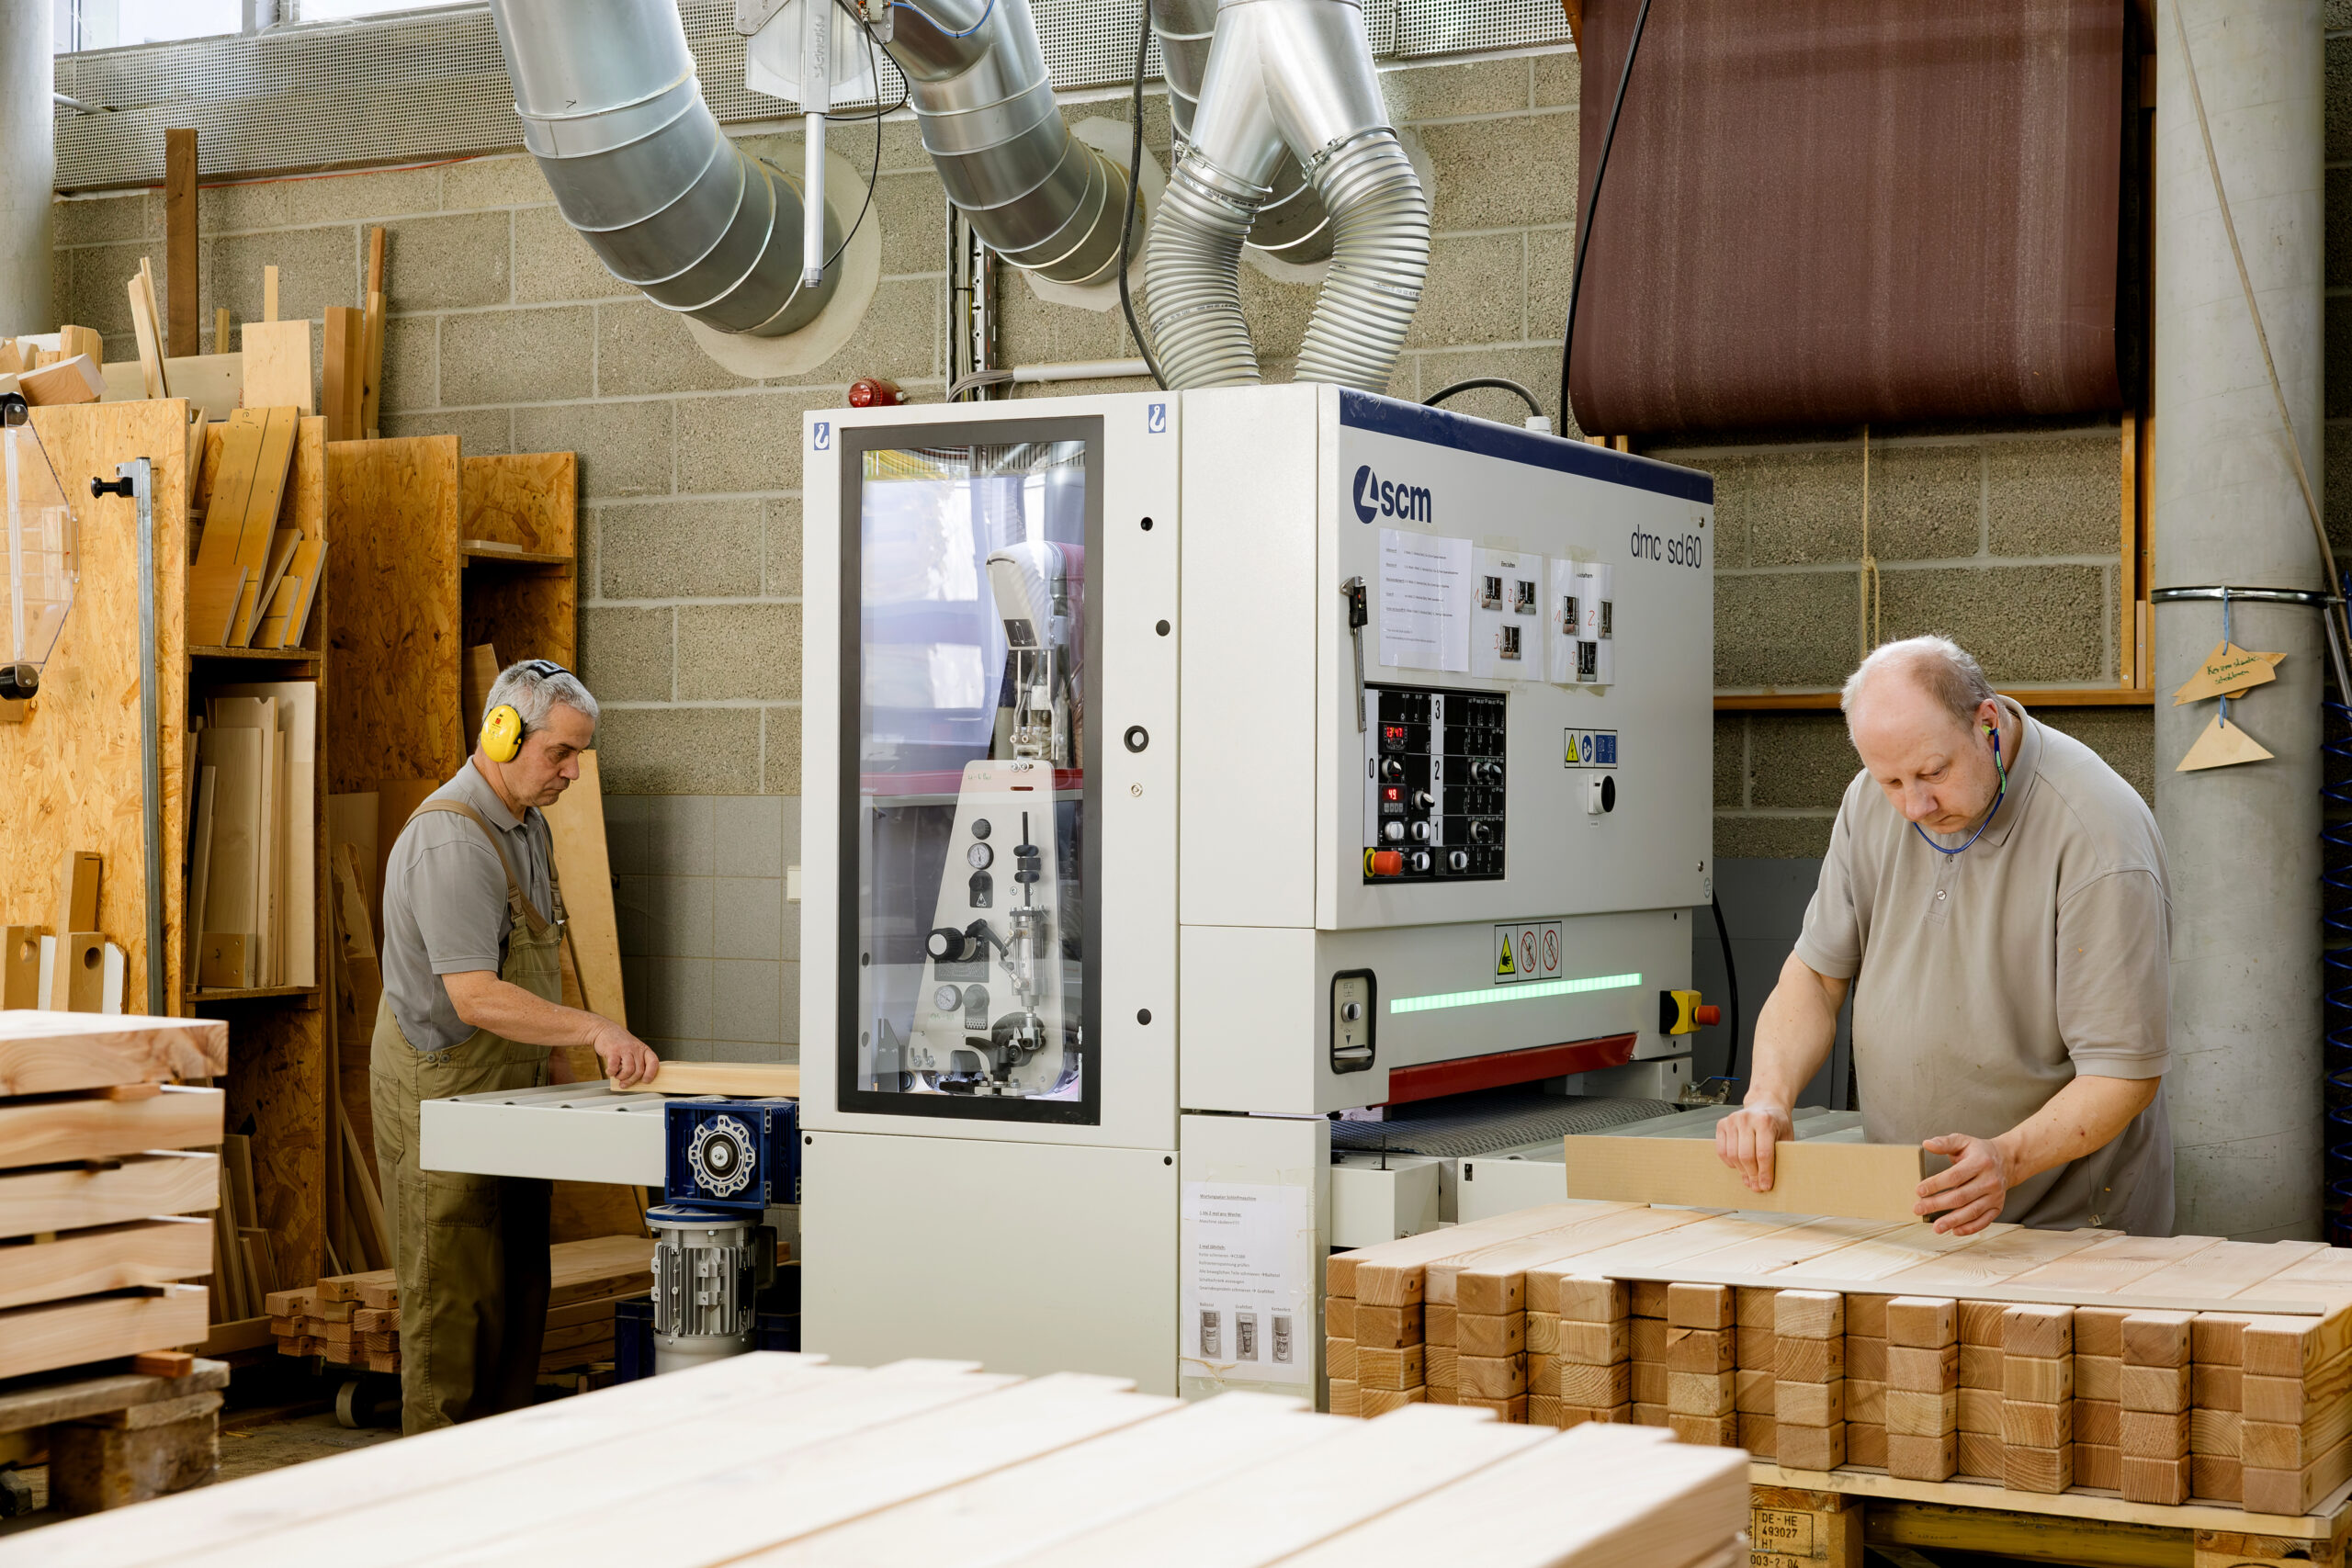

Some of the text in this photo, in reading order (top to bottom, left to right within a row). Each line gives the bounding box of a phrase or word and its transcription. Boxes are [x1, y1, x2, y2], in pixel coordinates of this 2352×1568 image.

[1381, 480, 1431, 524] scm
[1631, 524, 1702, 569] dmc sd60
[1435, 700, 1441, 719] 3
[1369, 758, 1374, 779] 0
[1434, 761, 1440, 780] 2
[1434, 820, 1439, 840] 1
[1762, 1525, 1798, 1539] 493027
